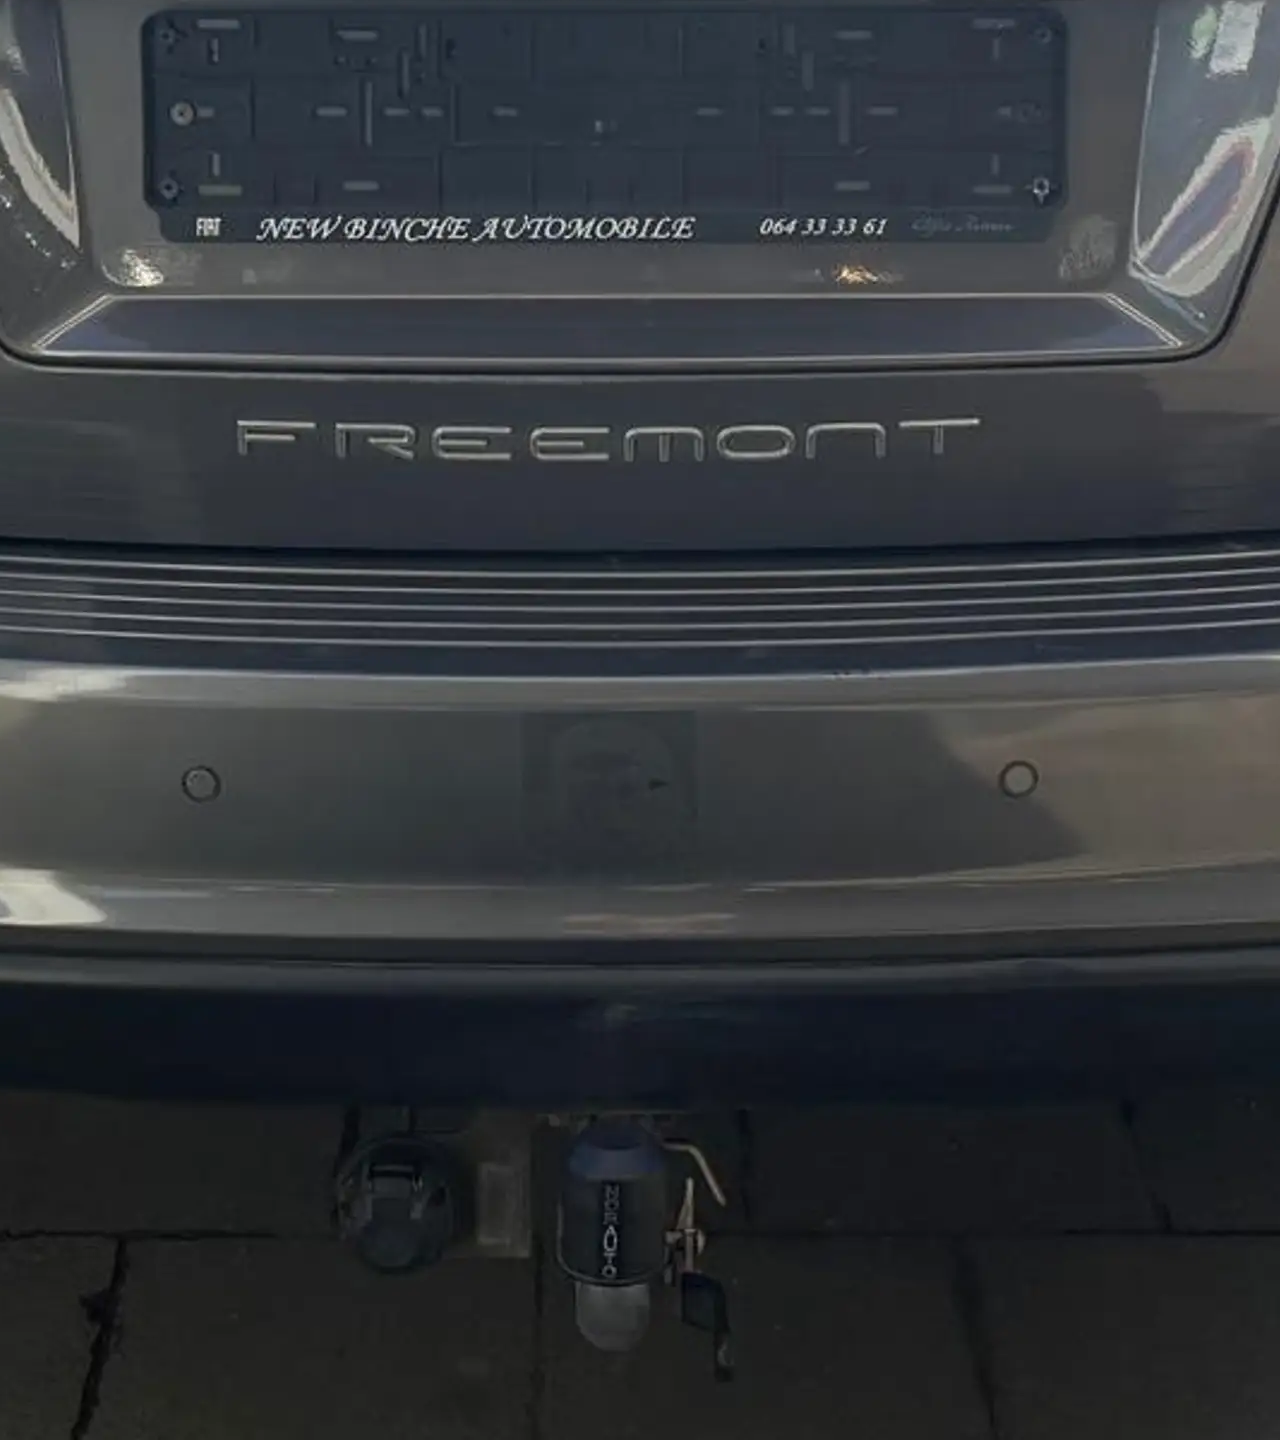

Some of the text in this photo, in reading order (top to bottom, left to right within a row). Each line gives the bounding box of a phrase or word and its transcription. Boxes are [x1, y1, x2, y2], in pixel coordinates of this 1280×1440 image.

[256, 215, 342, 241] NEW
[344, 217, 471, 241] BINCHE
[472, 215, 696, 242] AUTOMOBILE
[760, 218, 797, 235] 064
[801, 218, 827, 235] 33
[831, 218, 858, 236] 33
[862, 218, 888, 235] 61
[236, 417, 981, 462] FREEMONT
